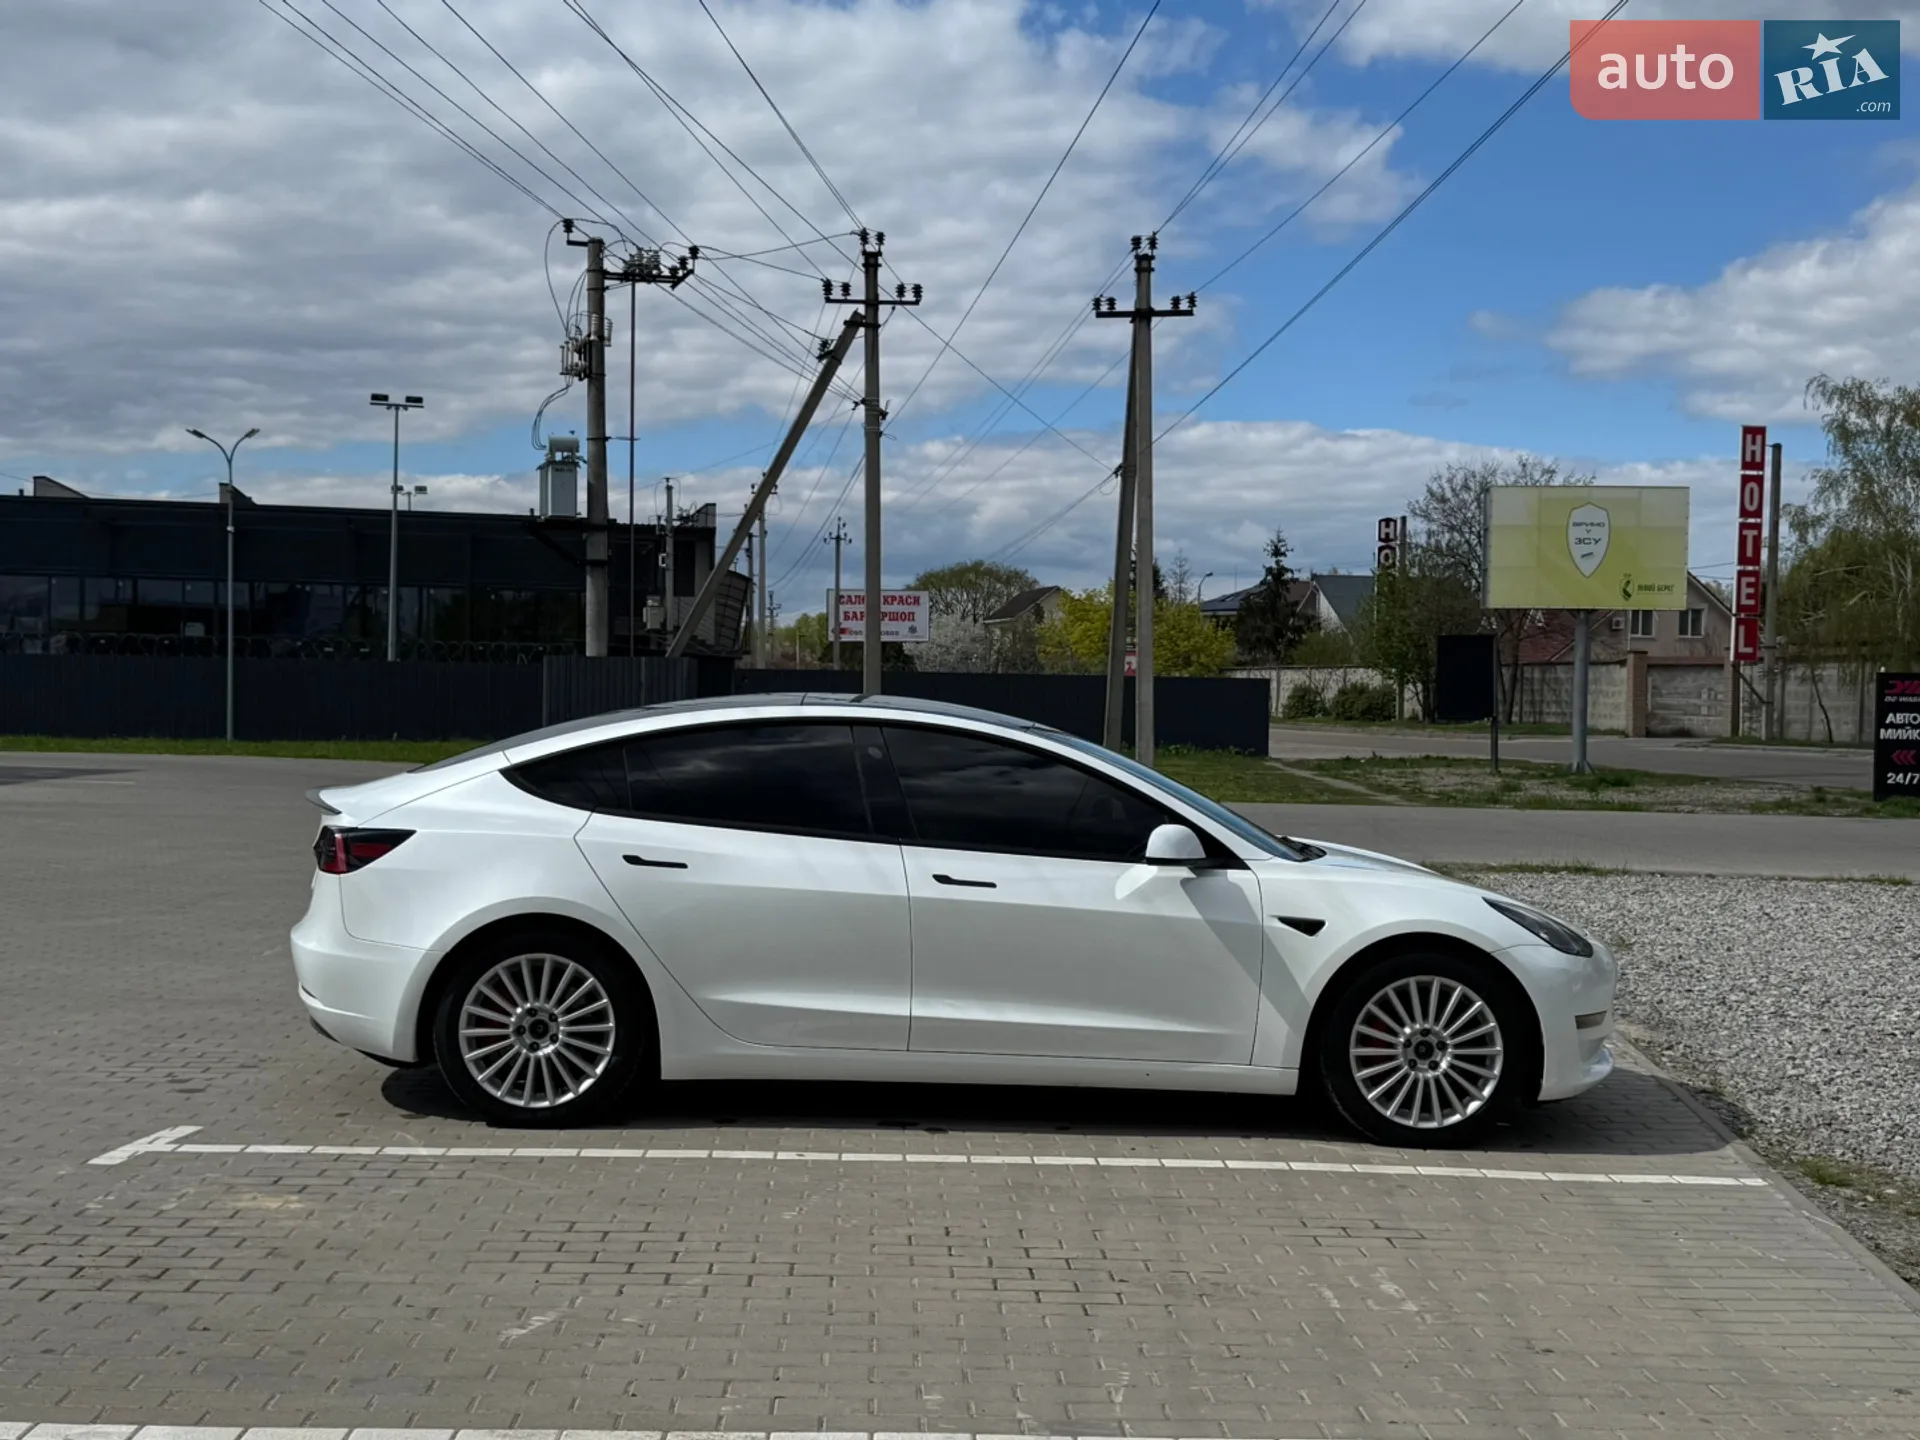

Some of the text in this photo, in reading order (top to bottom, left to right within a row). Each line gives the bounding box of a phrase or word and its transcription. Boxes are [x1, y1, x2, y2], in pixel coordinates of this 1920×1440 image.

[1574, 537, 1602, 545] ЗСУ
[1739, 434, 1762, 653] HOTEL
[883, 596, 921, 606] КРАСИ
[843, 611, 915, 622] БАРРШОП
[1886, 772, 1920, 785] 24/7
